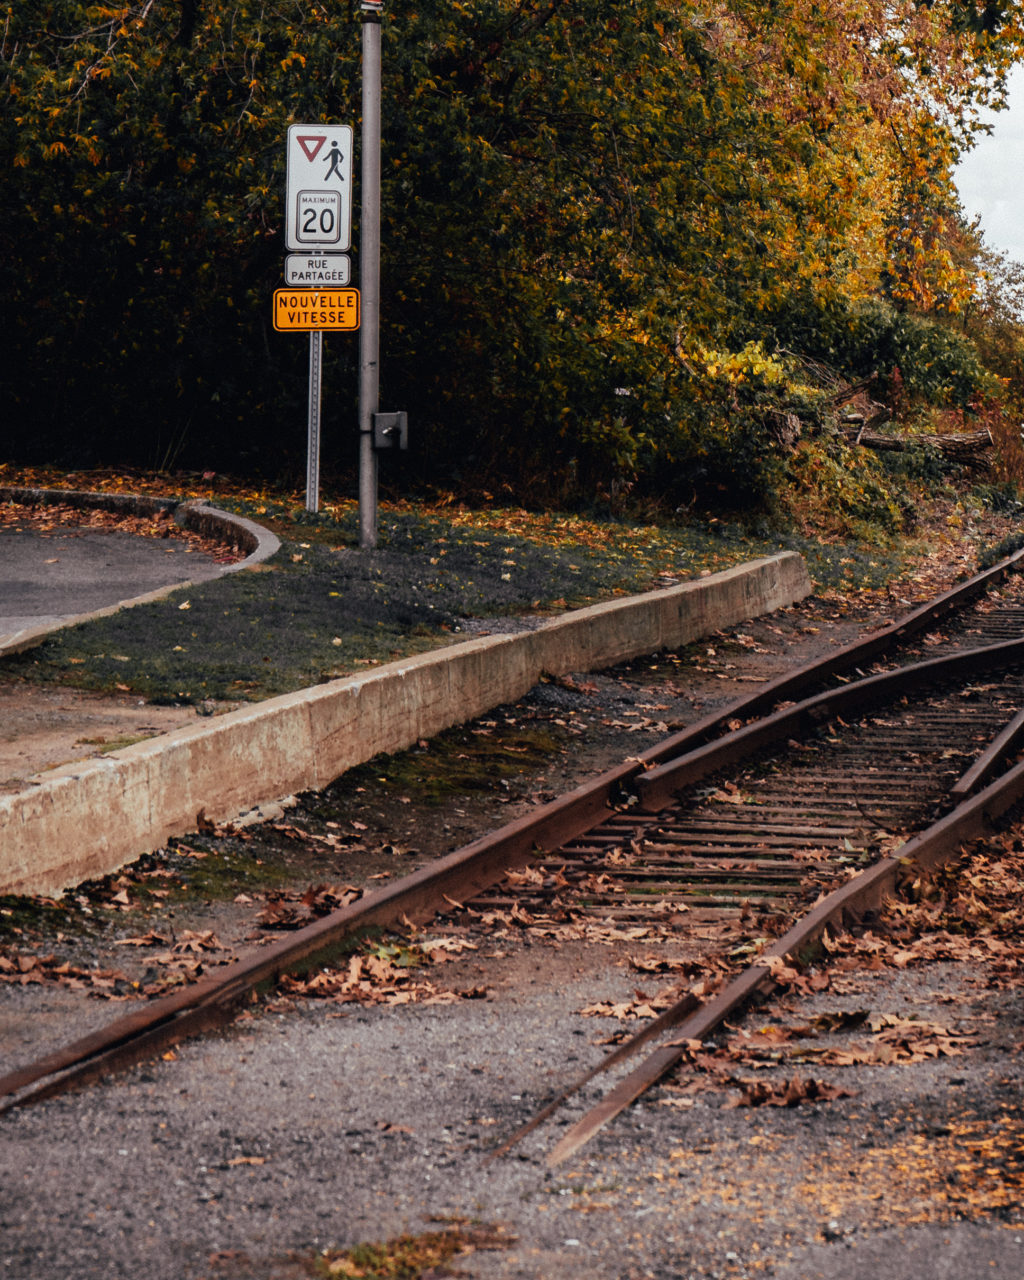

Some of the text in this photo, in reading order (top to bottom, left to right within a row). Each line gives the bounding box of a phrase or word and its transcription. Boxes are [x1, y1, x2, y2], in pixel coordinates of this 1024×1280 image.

[303, 208, 334, 233] 20
[307, 260, 328, 269] RUE
[291, 269, 344, 280] PARTAGÉE
[279, 296, 354, 308] NOUVELLE
[288, 311, 345, 323] VITESSE
